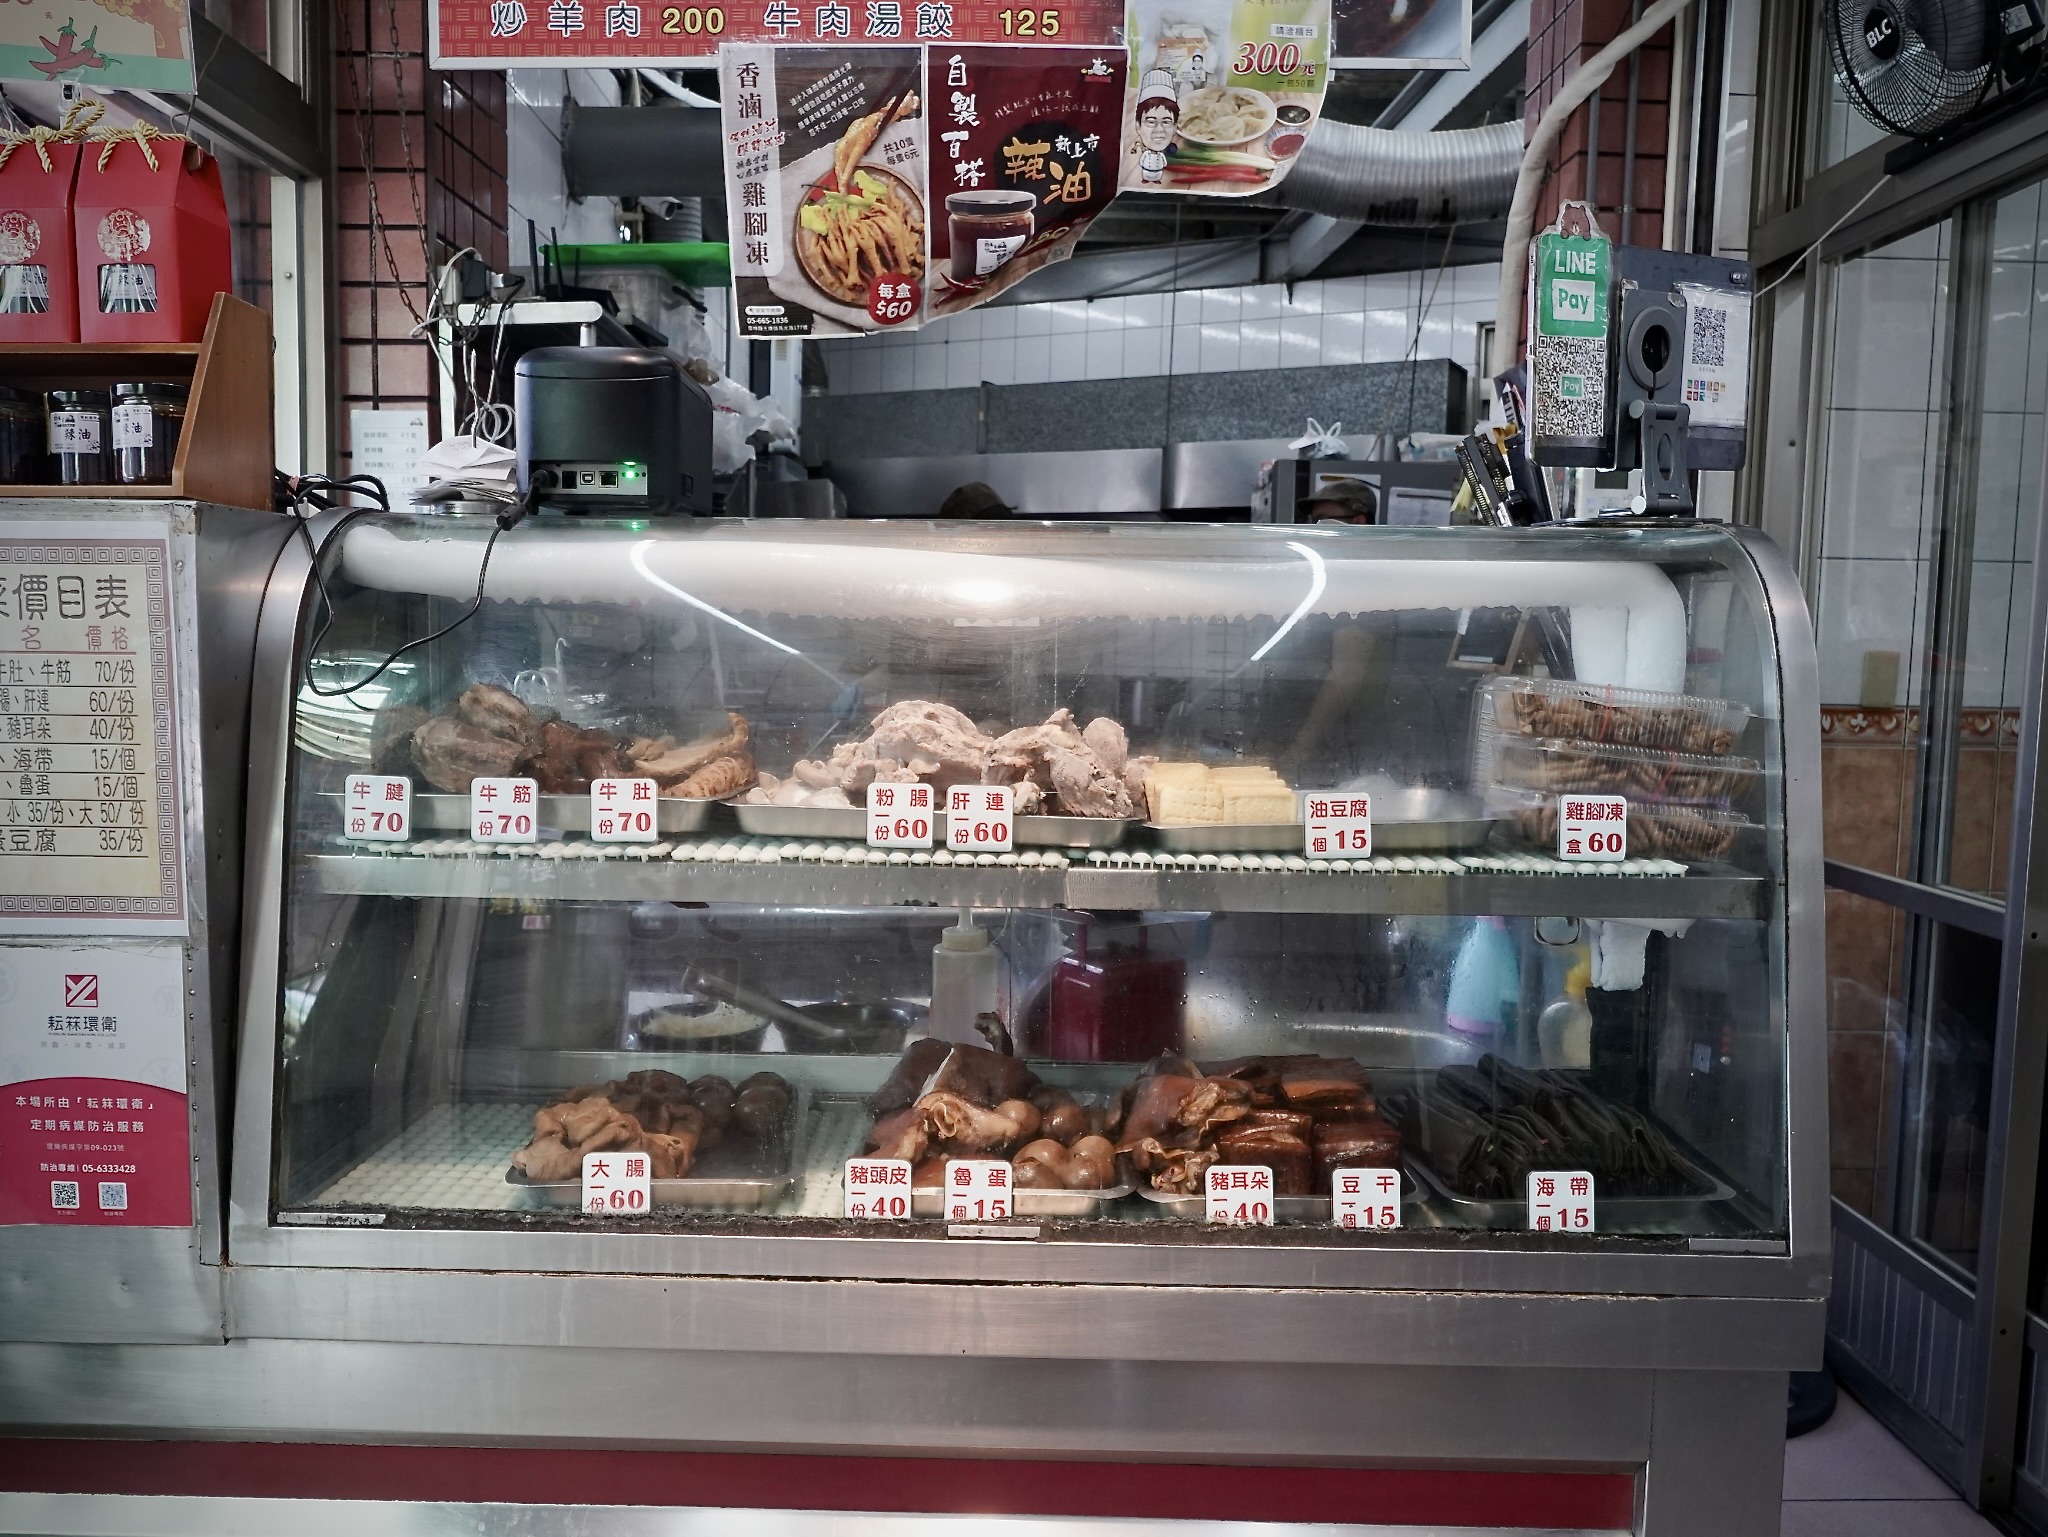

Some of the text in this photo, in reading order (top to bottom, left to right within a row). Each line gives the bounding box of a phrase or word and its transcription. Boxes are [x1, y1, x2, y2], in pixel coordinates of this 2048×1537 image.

[493, 2, 724, 37] 炒羊肉 200
[764, 2, 1060, 37] 牛肉湯餃 125
[1866, 18, 1892, 49] BLC
[1232, 41, 1316, 76] 300 元
[736, 62, 762, 119] 香滷
[941, 54, 986, 187] 自製百搭
[1055, 133, 1101, 158] 新上市
[1003, 136, 1093, 204] 辣油
[742, 182, 769, 267] 雞腳凍
[1554, 250, 1596, 275] LINE
[877, 283, 912, 299] 每盒
[875, 301, 912, 319] $60
[1558, 288, 1590, 315] Pay
[1564, 381, 1580, 393] Pay
[65, 428, 91, 441] 辣油
[21, 625, 128, 650] 名 價格
[95, 660, 134, 684] 70/份
[90, 690, 134, 714] 60/份
[90, 717, 134, 741] 40/份
[92, 748, 136, 771] 15/個
[95, 776, 138, 799] 15/個
[352, 783, 404, 801] 牛腱
[480, 784, 531, 804] 牛筋
[599, 783, 651, 801] 牛肚
[876, 788, 928, 807] 粉腸
[952, 792, 1005, 811] 肝連
[1310, 799, 1367, 819] 油豆腐
[7, 801, 20, 824] 小
[1565, 802, 1624, 822] 雞腳凍
[370, 812, 404, 833] 70
[497, 815, 531, 834] 70
[618, 812, 651, 833] 70
[894, 819, 928, 838] 60
[974, 822, 1008, 842] 60
[99, 829, 143, 853] 35/份
[1334, 829, 1367, 850] 15
[1588, 832, 1623, 853] 60
[30, 1119, 144, 1133] 定期病媒防治服務
[82, 1164, 136, 1174] 05-6333428
[591, 1159, 644, 1178] 大腸
[850, 1165, 907, 1185] 豬頭皮
[953, 1167, 1007, 1188] 魯蛋
[1211, 1171, 1269, 1191] 豬耳朵
[1341, 1175, 1395, 1194] 豆干
[1536, 1177, 1588, 1197] 海帶
[609, 1189, 644, 1209] 60
[871, 1197, 906, 1217] 40
[973, 1199, 1006, 1219] 15
[1233, 1202, 1268, 1222] 40
[1363, 1206, 1396, 1226] 15
[1557, 1208, 1589, 1228] 15
